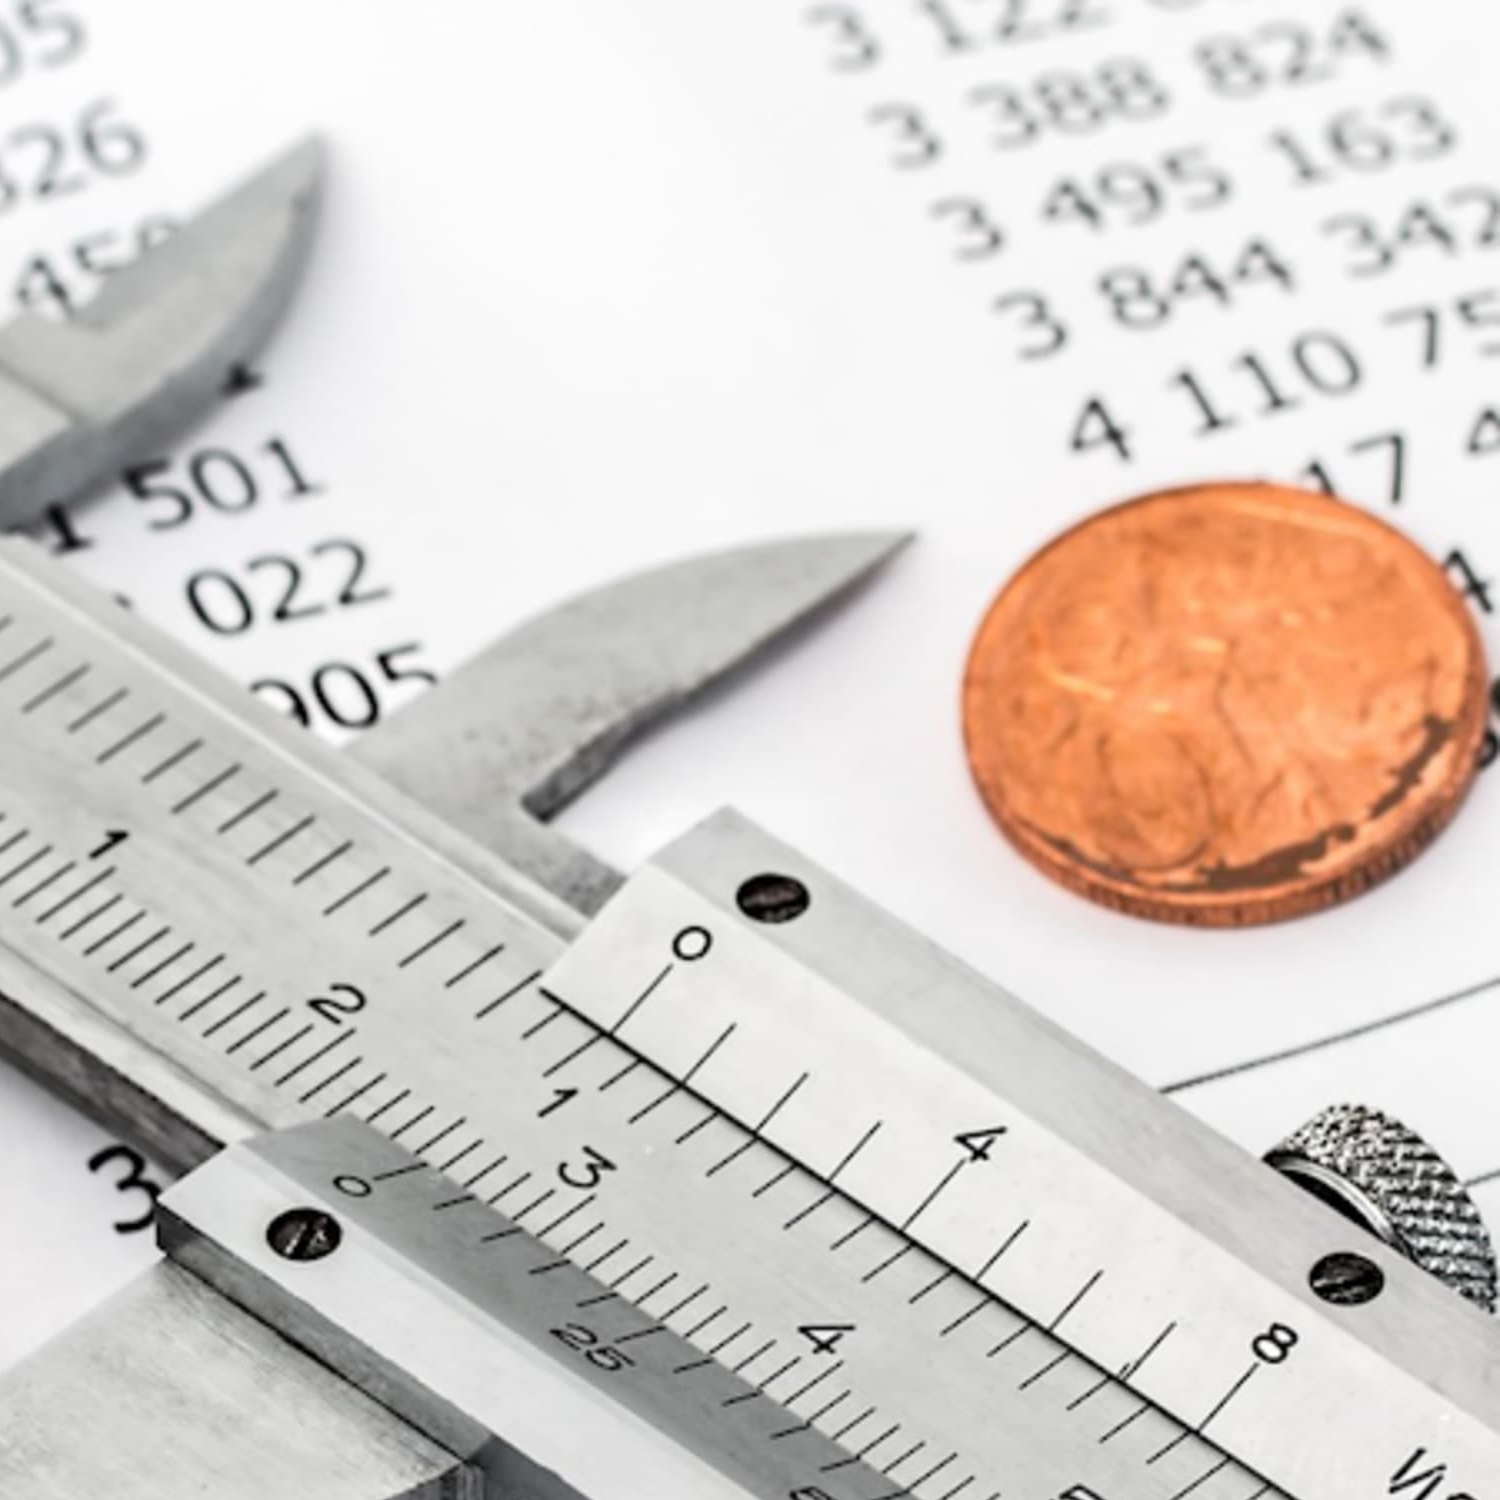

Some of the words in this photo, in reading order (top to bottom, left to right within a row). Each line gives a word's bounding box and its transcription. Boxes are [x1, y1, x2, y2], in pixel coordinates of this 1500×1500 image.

[803, 3, 881, 73] 3
[867, 100, 943, 170] 3
[963, 55, 1173, 150] 388
[1193, 8, 1392, 100] 824
[930, 195, 1006, 262] 3
[1040, 147, 1233, 231] 495
[1268, 95, 1460, 187] 163
[992, 289, 1071, 362] 3
[1096, 236, 1298, 332] 844
[1067, 396, 1134, 463] 4
[1168, 330, 1364, 438] 110
[120, 438, 322, 532] 501
[183, 550, 393, 635] 022
[89, 829, 129, 859] 1
[308, 982, 367, 1025] 2
[559, 1146, 617, 1191] 3
[798, 1322, 856, 1356] 4
[672, 927, 712, 961] 0
[954, 1125, 1008, 1165] 4
[1251, 1322, 1299, 1366] 8
[549, 1323, 635, 1374] 25
